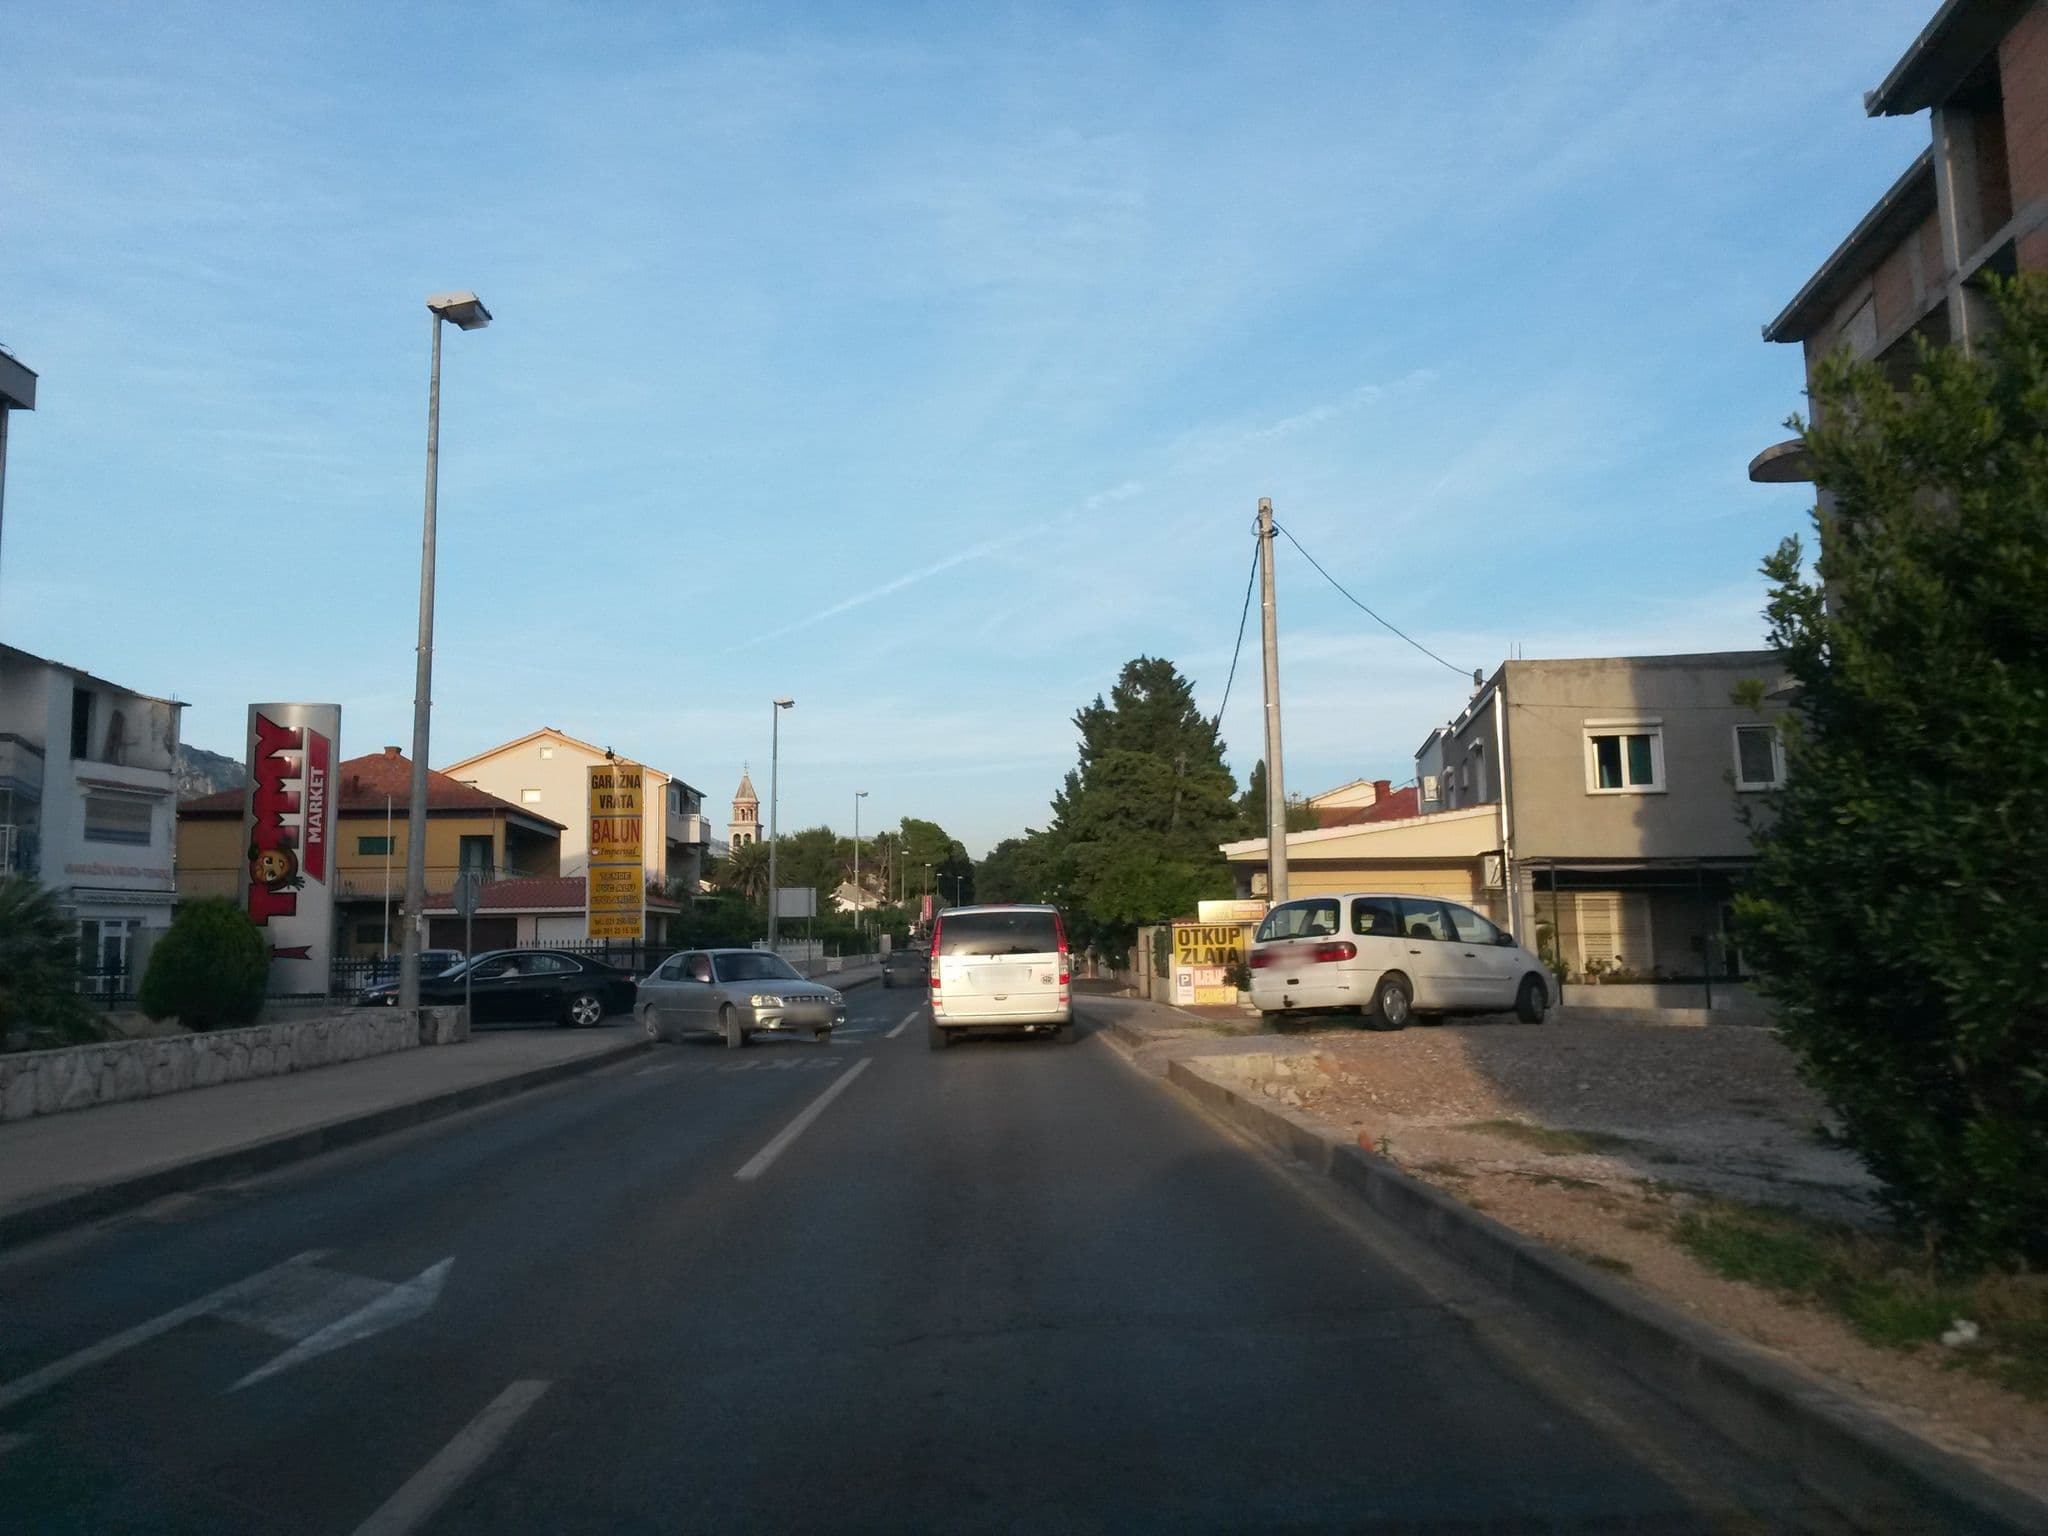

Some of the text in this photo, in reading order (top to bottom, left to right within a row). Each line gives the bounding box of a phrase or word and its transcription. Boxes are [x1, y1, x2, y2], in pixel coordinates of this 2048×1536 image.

[592, 771, 641, 789] GARAŽNA
[308, 767, 324, 843] MARKET
[599, 794, 634, 809] VRATA
[592, 819, 640, 843] BALUN
[1178, 927, 1241, 946] OTKUP
[1180, 947, 1240, 964] ZLATA
